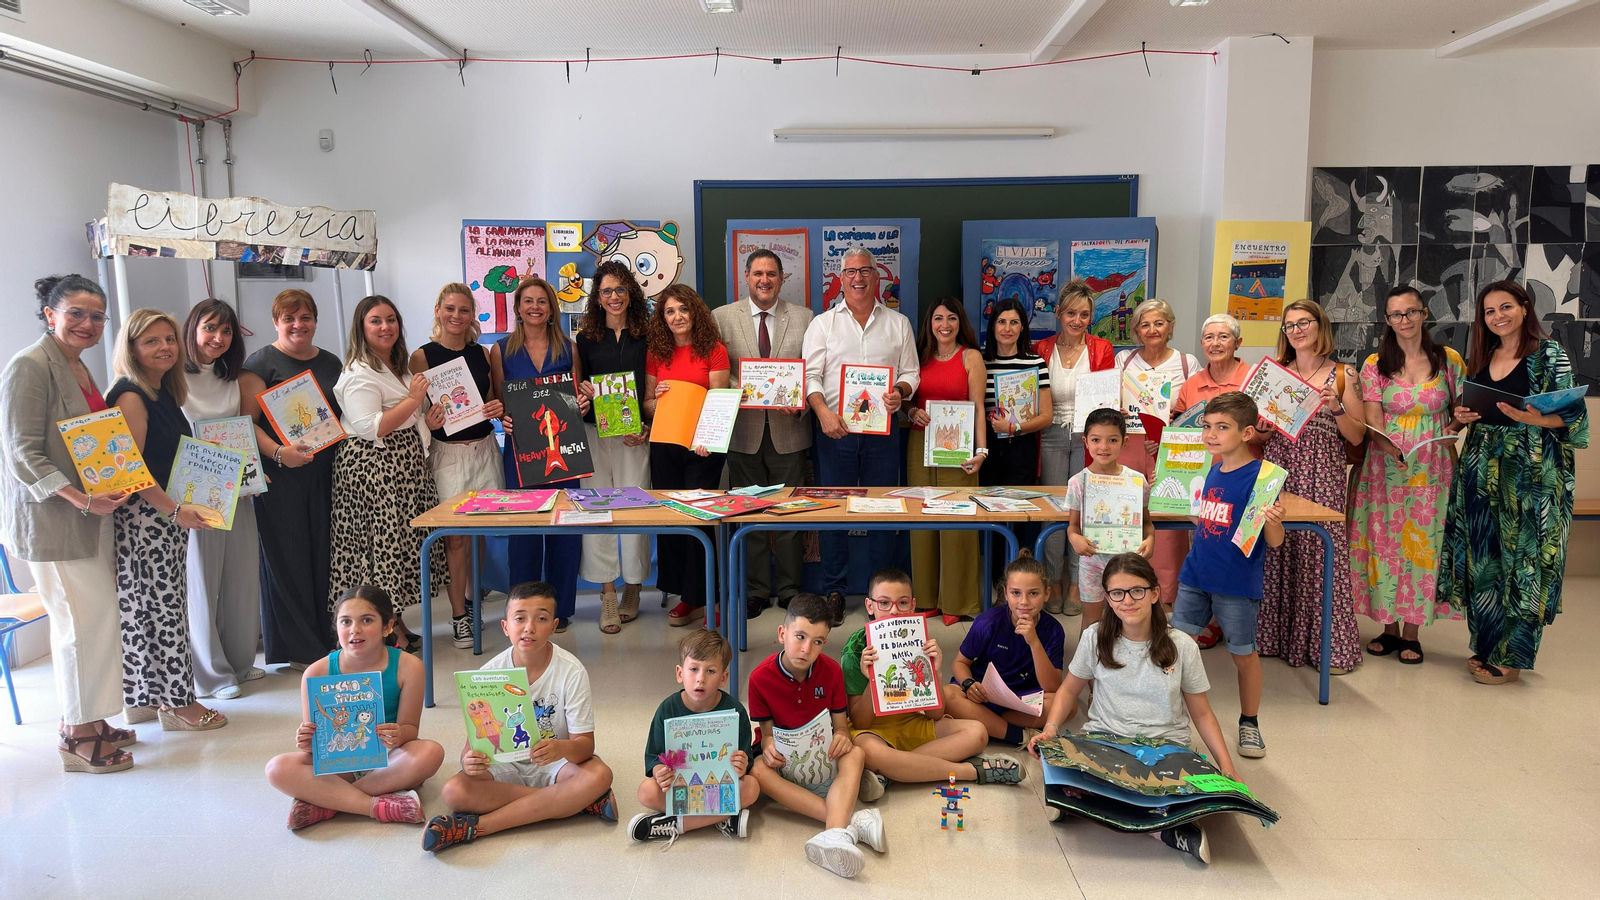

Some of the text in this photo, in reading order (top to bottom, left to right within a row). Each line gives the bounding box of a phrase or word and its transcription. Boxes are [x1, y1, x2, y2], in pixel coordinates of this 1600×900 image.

[468, 226, 480, 235] LA
[824, 230, 836, 241] LA
[886, 230, 899, 240] LA
[470, 236, 481, 244] DE
[1012, 247, 1045, 257] VIAJE
[1235, 244, 1286, 252] ENCUENTRO
[534, 372, 574, 386] MUSICAL
[186, 443, 199, 452] LOS
[519, 442, 586, 463] HEAVY METAL
[1199, 500, 1229, 524] ARVEL
[875, 622, 885, 630] LAS
[892, 639, 924, 649] DIAMANTE
[814, 686, 824, 696] M
[674, 728, 721, 739] AVENTURAS
